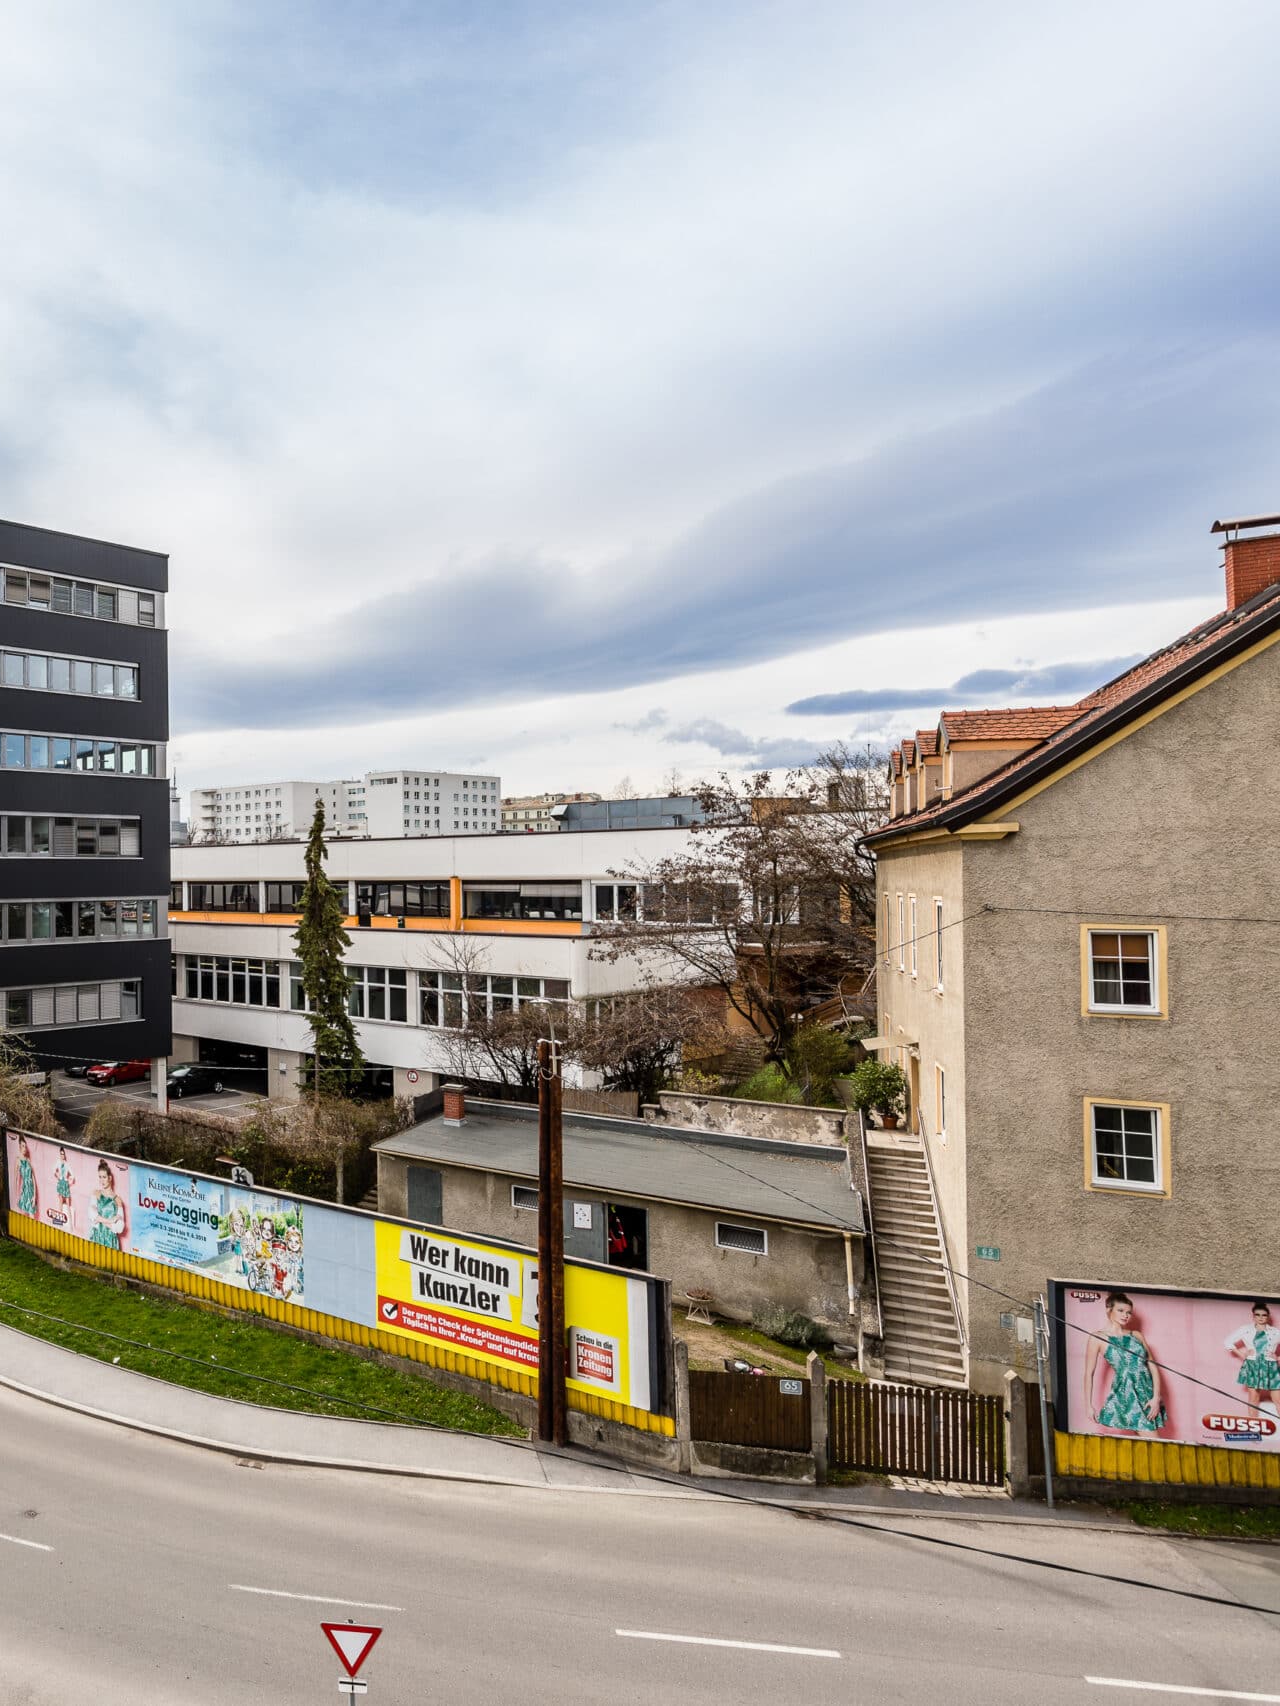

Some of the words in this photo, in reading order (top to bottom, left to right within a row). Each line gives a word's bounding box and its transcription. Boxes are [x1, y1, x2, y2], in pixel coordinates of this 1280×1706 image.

[138, 1192, 166, 1212] Love
[166, 1201, 219, 1230] Jogging
[410, 1234, 449, 1269] Wer
[454, 1247, 509, 1288] kann
[419, 1272, 500, 1313] Kanzler
[1073, 1291, 1099, 1299] FUSSL
[402, 1307, 416, 1317] Der
[438, 1317, 461, 1330] Check
[462, 1323, 476, 1334] der
[476, 1328, 539, 1354] Spitzenkandida
[430, 1322, 438, 1333] in
[487, 1340, 502, 1352] und
[504, 1345, 518, 1356] auf
[518, 1349, 539, 1363] kron
[577, 1345, 612, 1365] Kronen
[578, 1356, 612, 1377] Zeitung
[784, 1381, 798, 1391] 65
[1210, 1416, 1272, 1433] FUSSL
